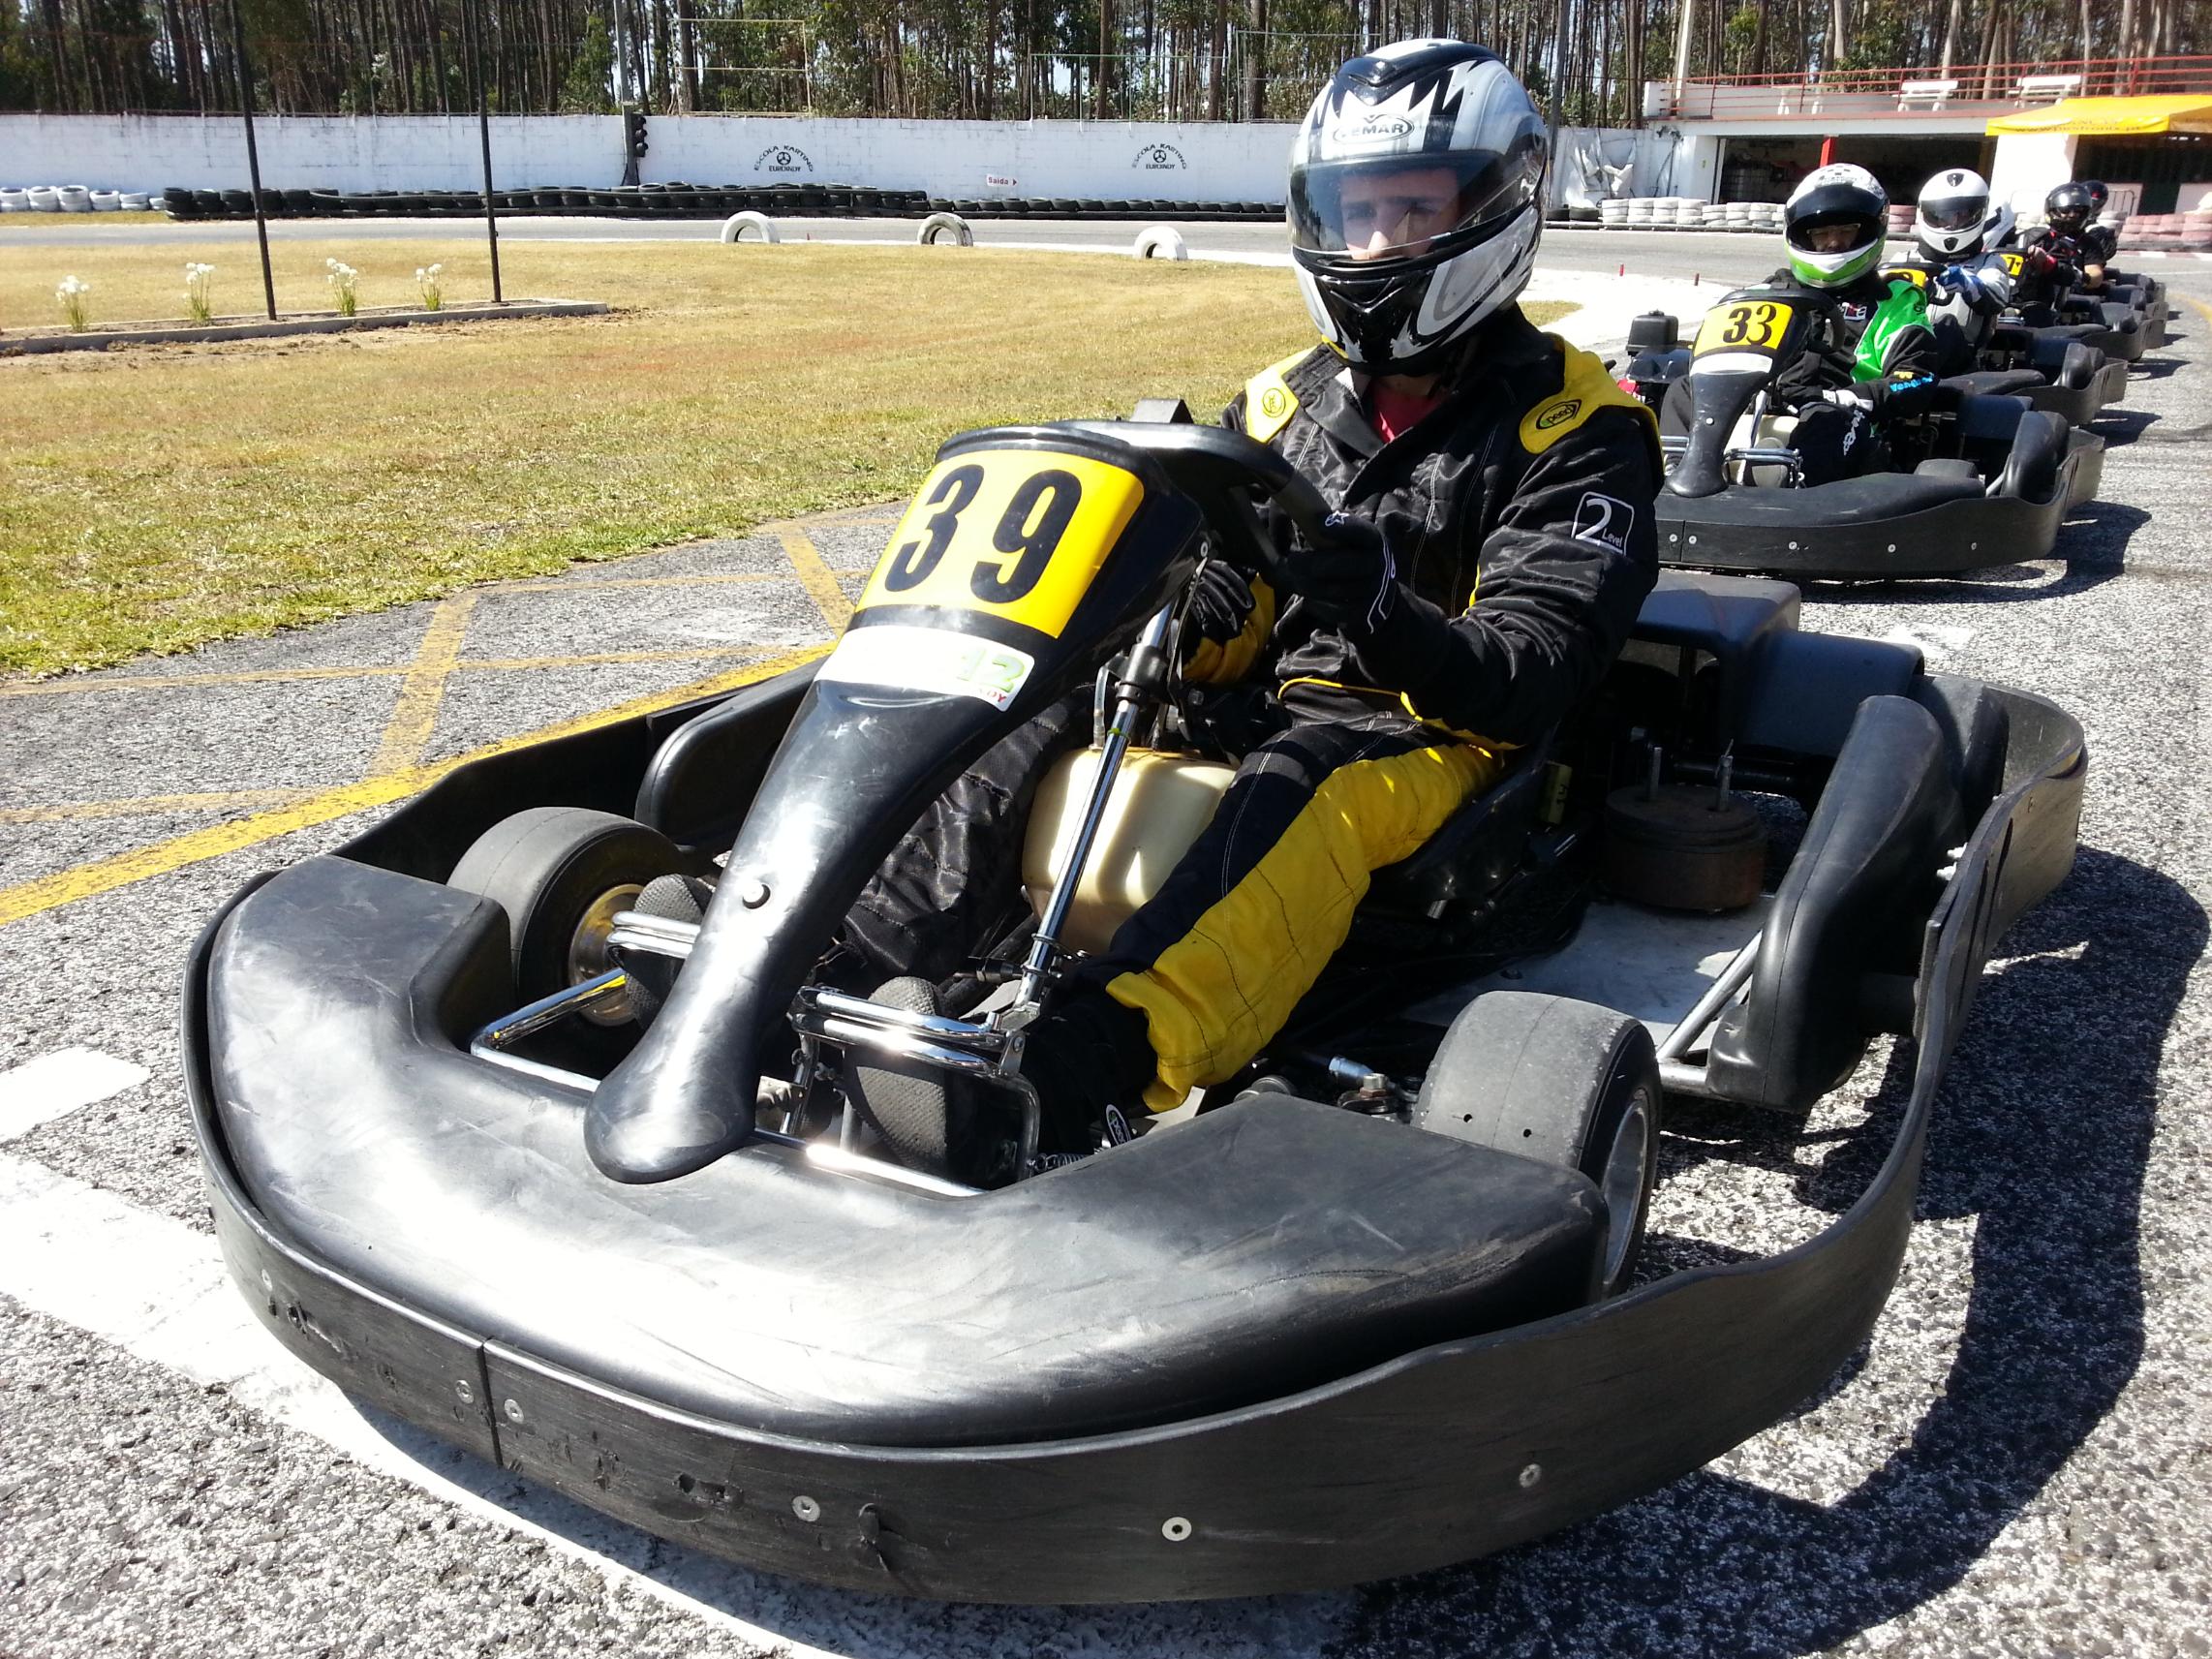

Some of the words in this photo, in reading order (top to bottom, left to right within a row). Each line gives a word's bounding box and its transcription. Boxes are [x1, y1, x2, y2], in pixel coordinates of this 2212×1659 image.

[783, 145, 814, 172] KARTING
[1722, 303, 1777, 346] 33
[884, 464, 1083, 604] 39
[1575, 497, 1624, 555] 2
[1601, 527, 1623, 549] Level
